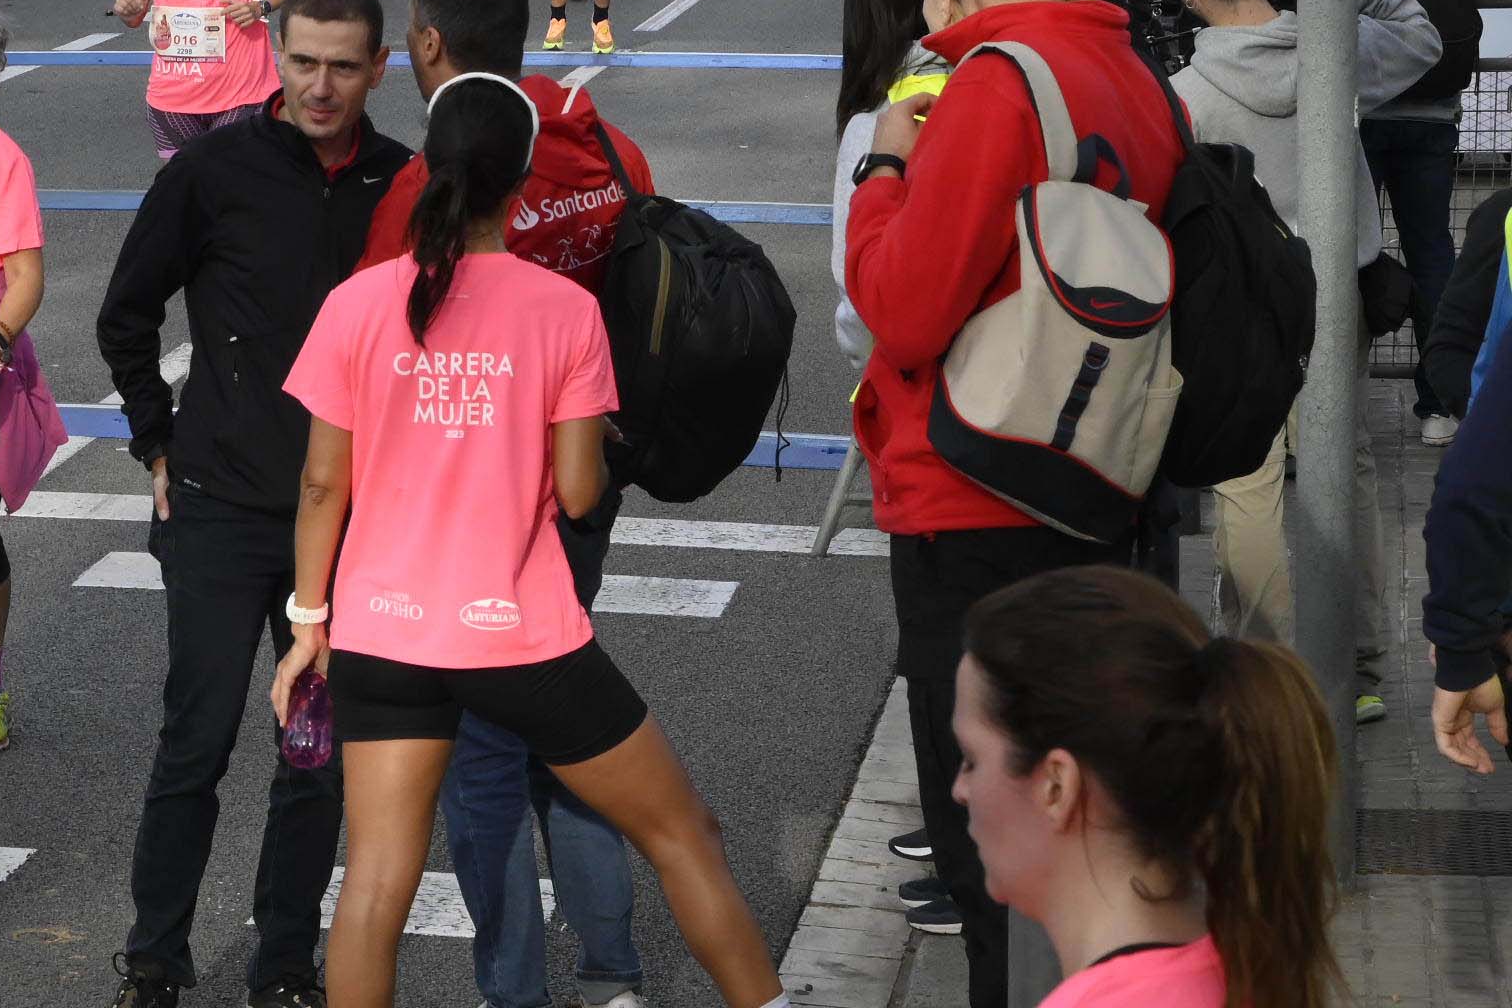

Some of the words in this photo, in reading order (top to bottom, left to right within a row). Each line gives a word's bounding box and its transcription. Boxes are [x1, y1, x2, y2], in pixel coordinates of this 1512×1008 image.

[173, 35, 198, 46] 016
[540, 180, 627, 223] Santande
[392, 352, 515, 377] CARRERA
[418, 377, 452, 401] DE
[461, 377, 492, 401] LA
[413, 402, 495, 426] MUJER
[369, 596, 423, 621] OYSHO
[465, 606, 520, 623] ASTURIANA
